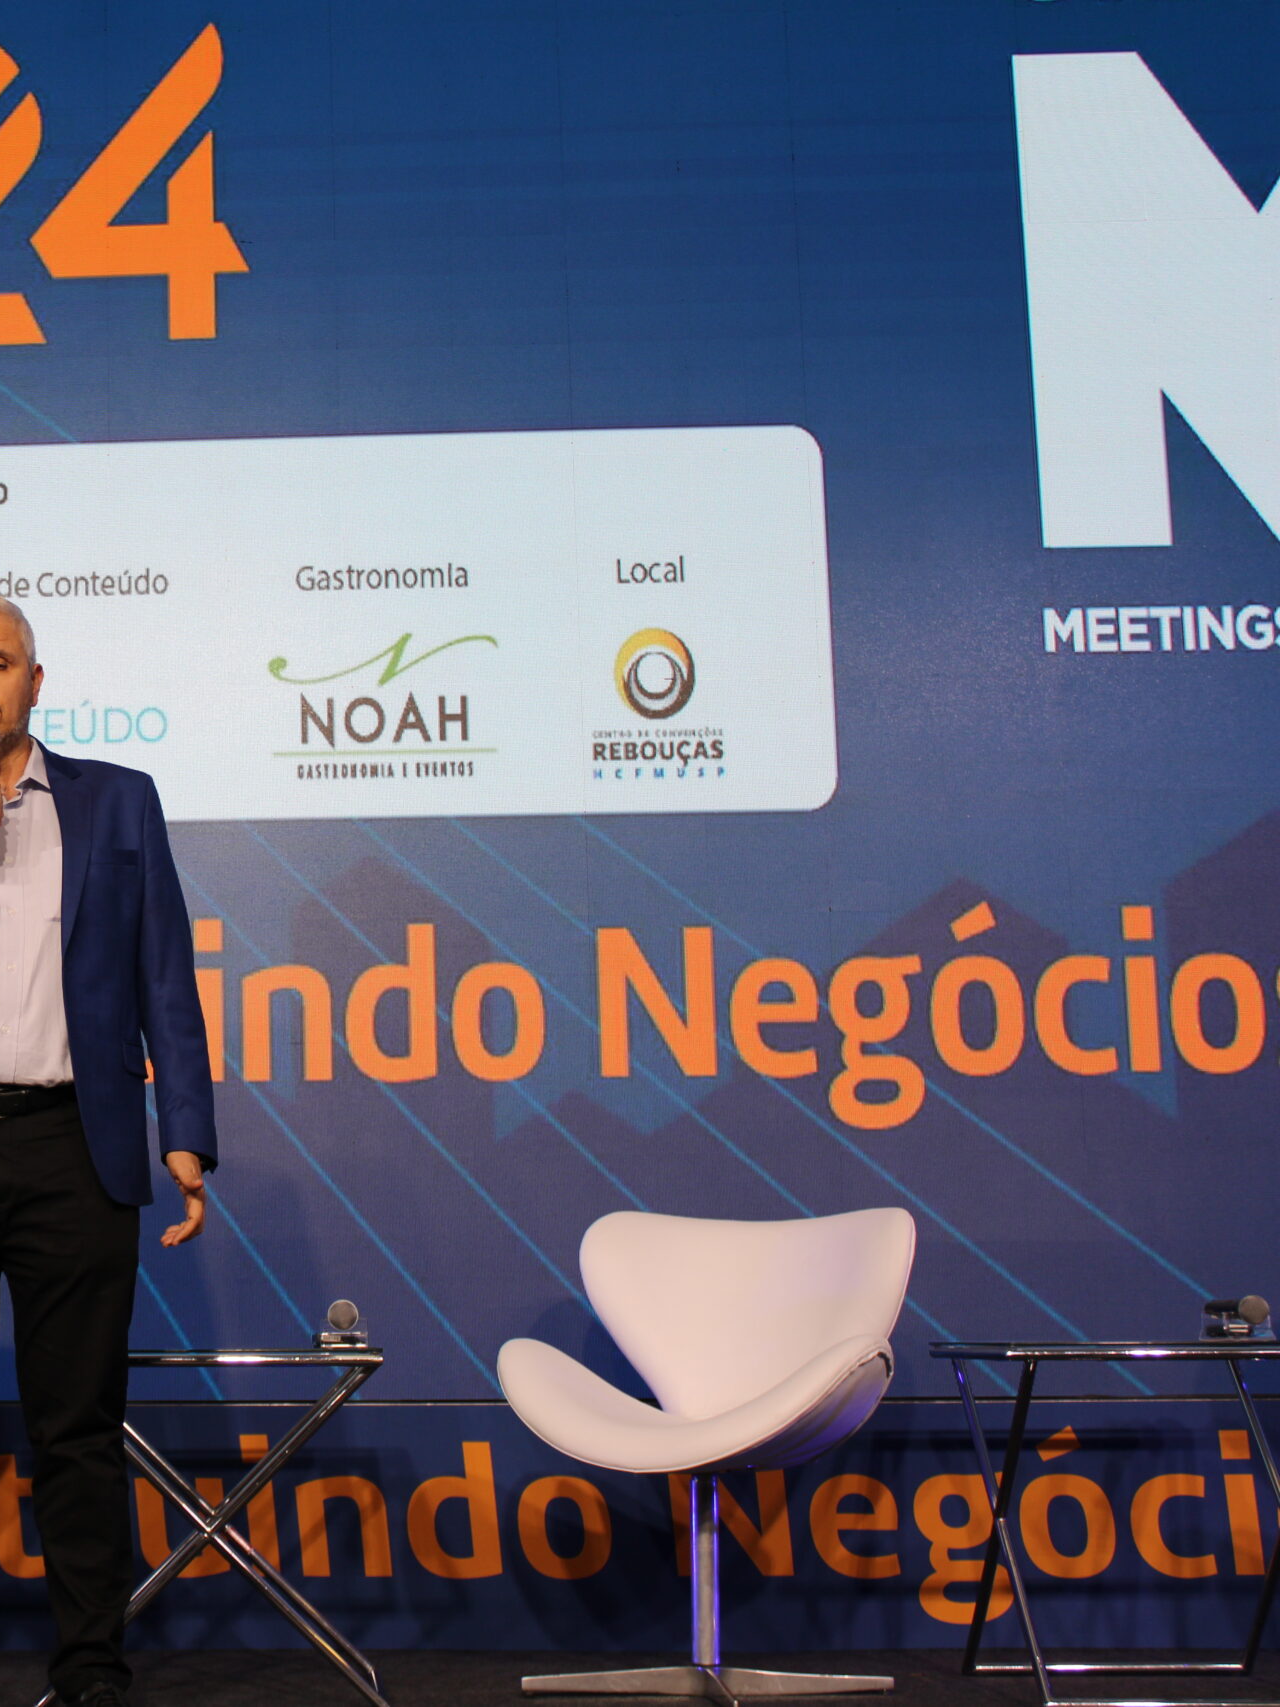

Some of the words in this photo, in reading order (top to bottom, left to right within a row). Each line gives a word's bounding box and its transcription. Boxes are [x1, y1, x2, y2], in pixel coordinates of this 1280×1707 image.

[36, 568, 169, 597] Conteúdo
[295, 562, 469, 592] Gastronomia
[616, 555, 685, 585] Local
[299, 690, 470, 749] NOAH
[593, 740, 723, 767] REBOUÇAS
[297, 762, 396, 780] GASTRONOMIA
[415, 760, 475, 777] EVENTOS
[596, 901, 1280, 1130] Negócio
[668, 1426, 1280, 1625] Negóci
